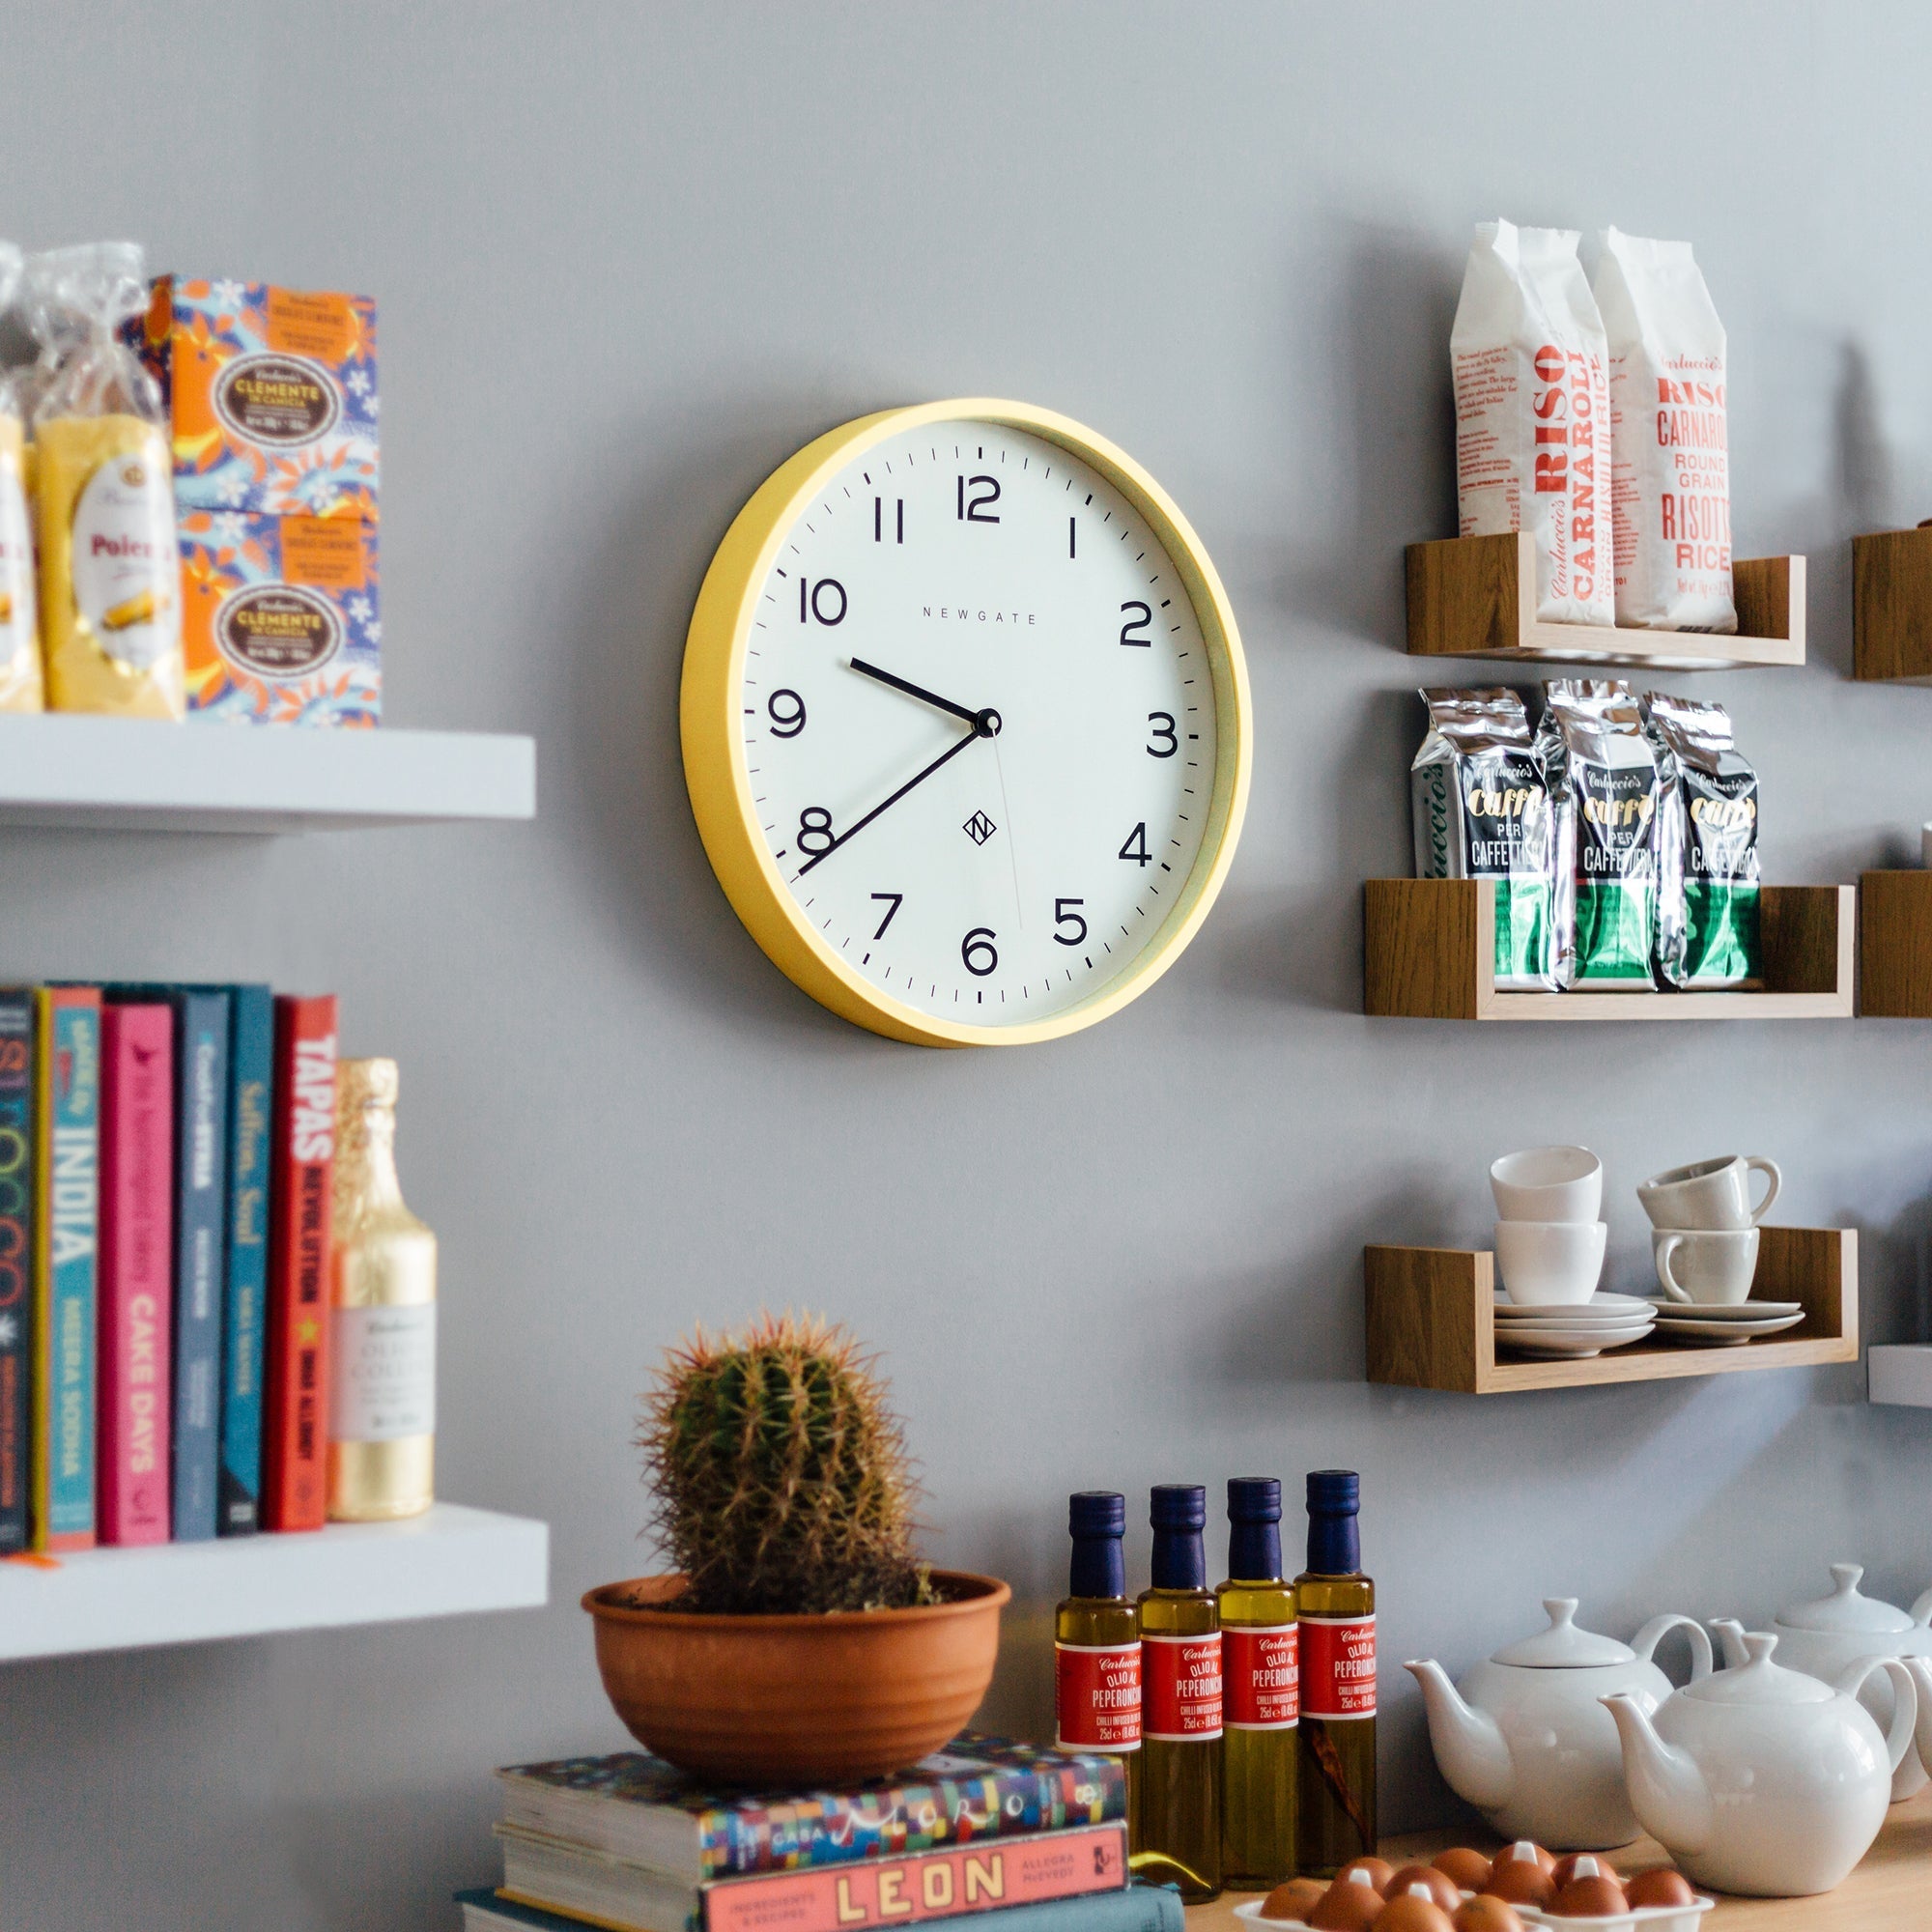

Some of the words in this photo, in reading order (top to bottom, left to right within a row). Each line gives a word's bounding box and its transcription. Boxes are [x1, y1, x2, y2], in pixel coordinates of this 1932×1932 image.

[1533, 345, 1568, 495] RISO
[1657, 410, 1727, 451] CARNARO
[1566, 350, 1595, 601] CARNAROLI
[1675, 453, 1725, 472] ROUND
[1679, 472, 1725, 491] GRAIN
[875, 497, 903, 544] 11
[958, 474, 1001, 524] 12
[1069, 517, 1076, 558] 1
[1549, 499, 1568, 600] Carluccio's
[1676, 543, 1730, 571] RICE
[800, 578, 847, 626] 10
[923, 607, 1036, 625] NEWGATE
[1121, 601, 1151, 647] 2
[768, 689, 806, 738] 9
[1147, 712, 1178, 758] 3
[797, 806, 835, 858] 8
[1423, 763, 1448, 878] uccio's
[1497, 823, 1521, 838] PER
[1609, 832, 1634, 845] PER
[1119, 822, 1151, 867] 4
[871, 894, 902, 940] 7
[1053, 898, 1087, 946] 5
[961, 927, 998, 976] 6
[293, 1035, 335, 1161] TAPAS
[53, 1127, 95, 1264] INDIA
[130, 1293, 156, 1383] CAKE
[130, 1391, 155, 1474] DAYS
[1099, 1656, 1140, 1670] Carluccio
[1182, 1646, 1221, 1661] Carluccio
[1259, 1636, 1297, 1651] Carluccio
[1266, 1652, 1286, 1667] OLIO
[1348, 1642, 1367, 1659] OLIO
[1106, 1671, 1127, 1688] OLIO
[1190, 1662, 1210, 1677] OLIO
[1334, 1656, 1376, 1678] PEPERONC
[1183, 1718, 1196, 1729] 25cl
[1260, 1706, 1272, 1719] 25cl
[1341, 1696, 1352, 1709] 25cl
[1099, 1727, 1112, 1740] 25cl
[838, 1854, 1003, 1922] LEON
